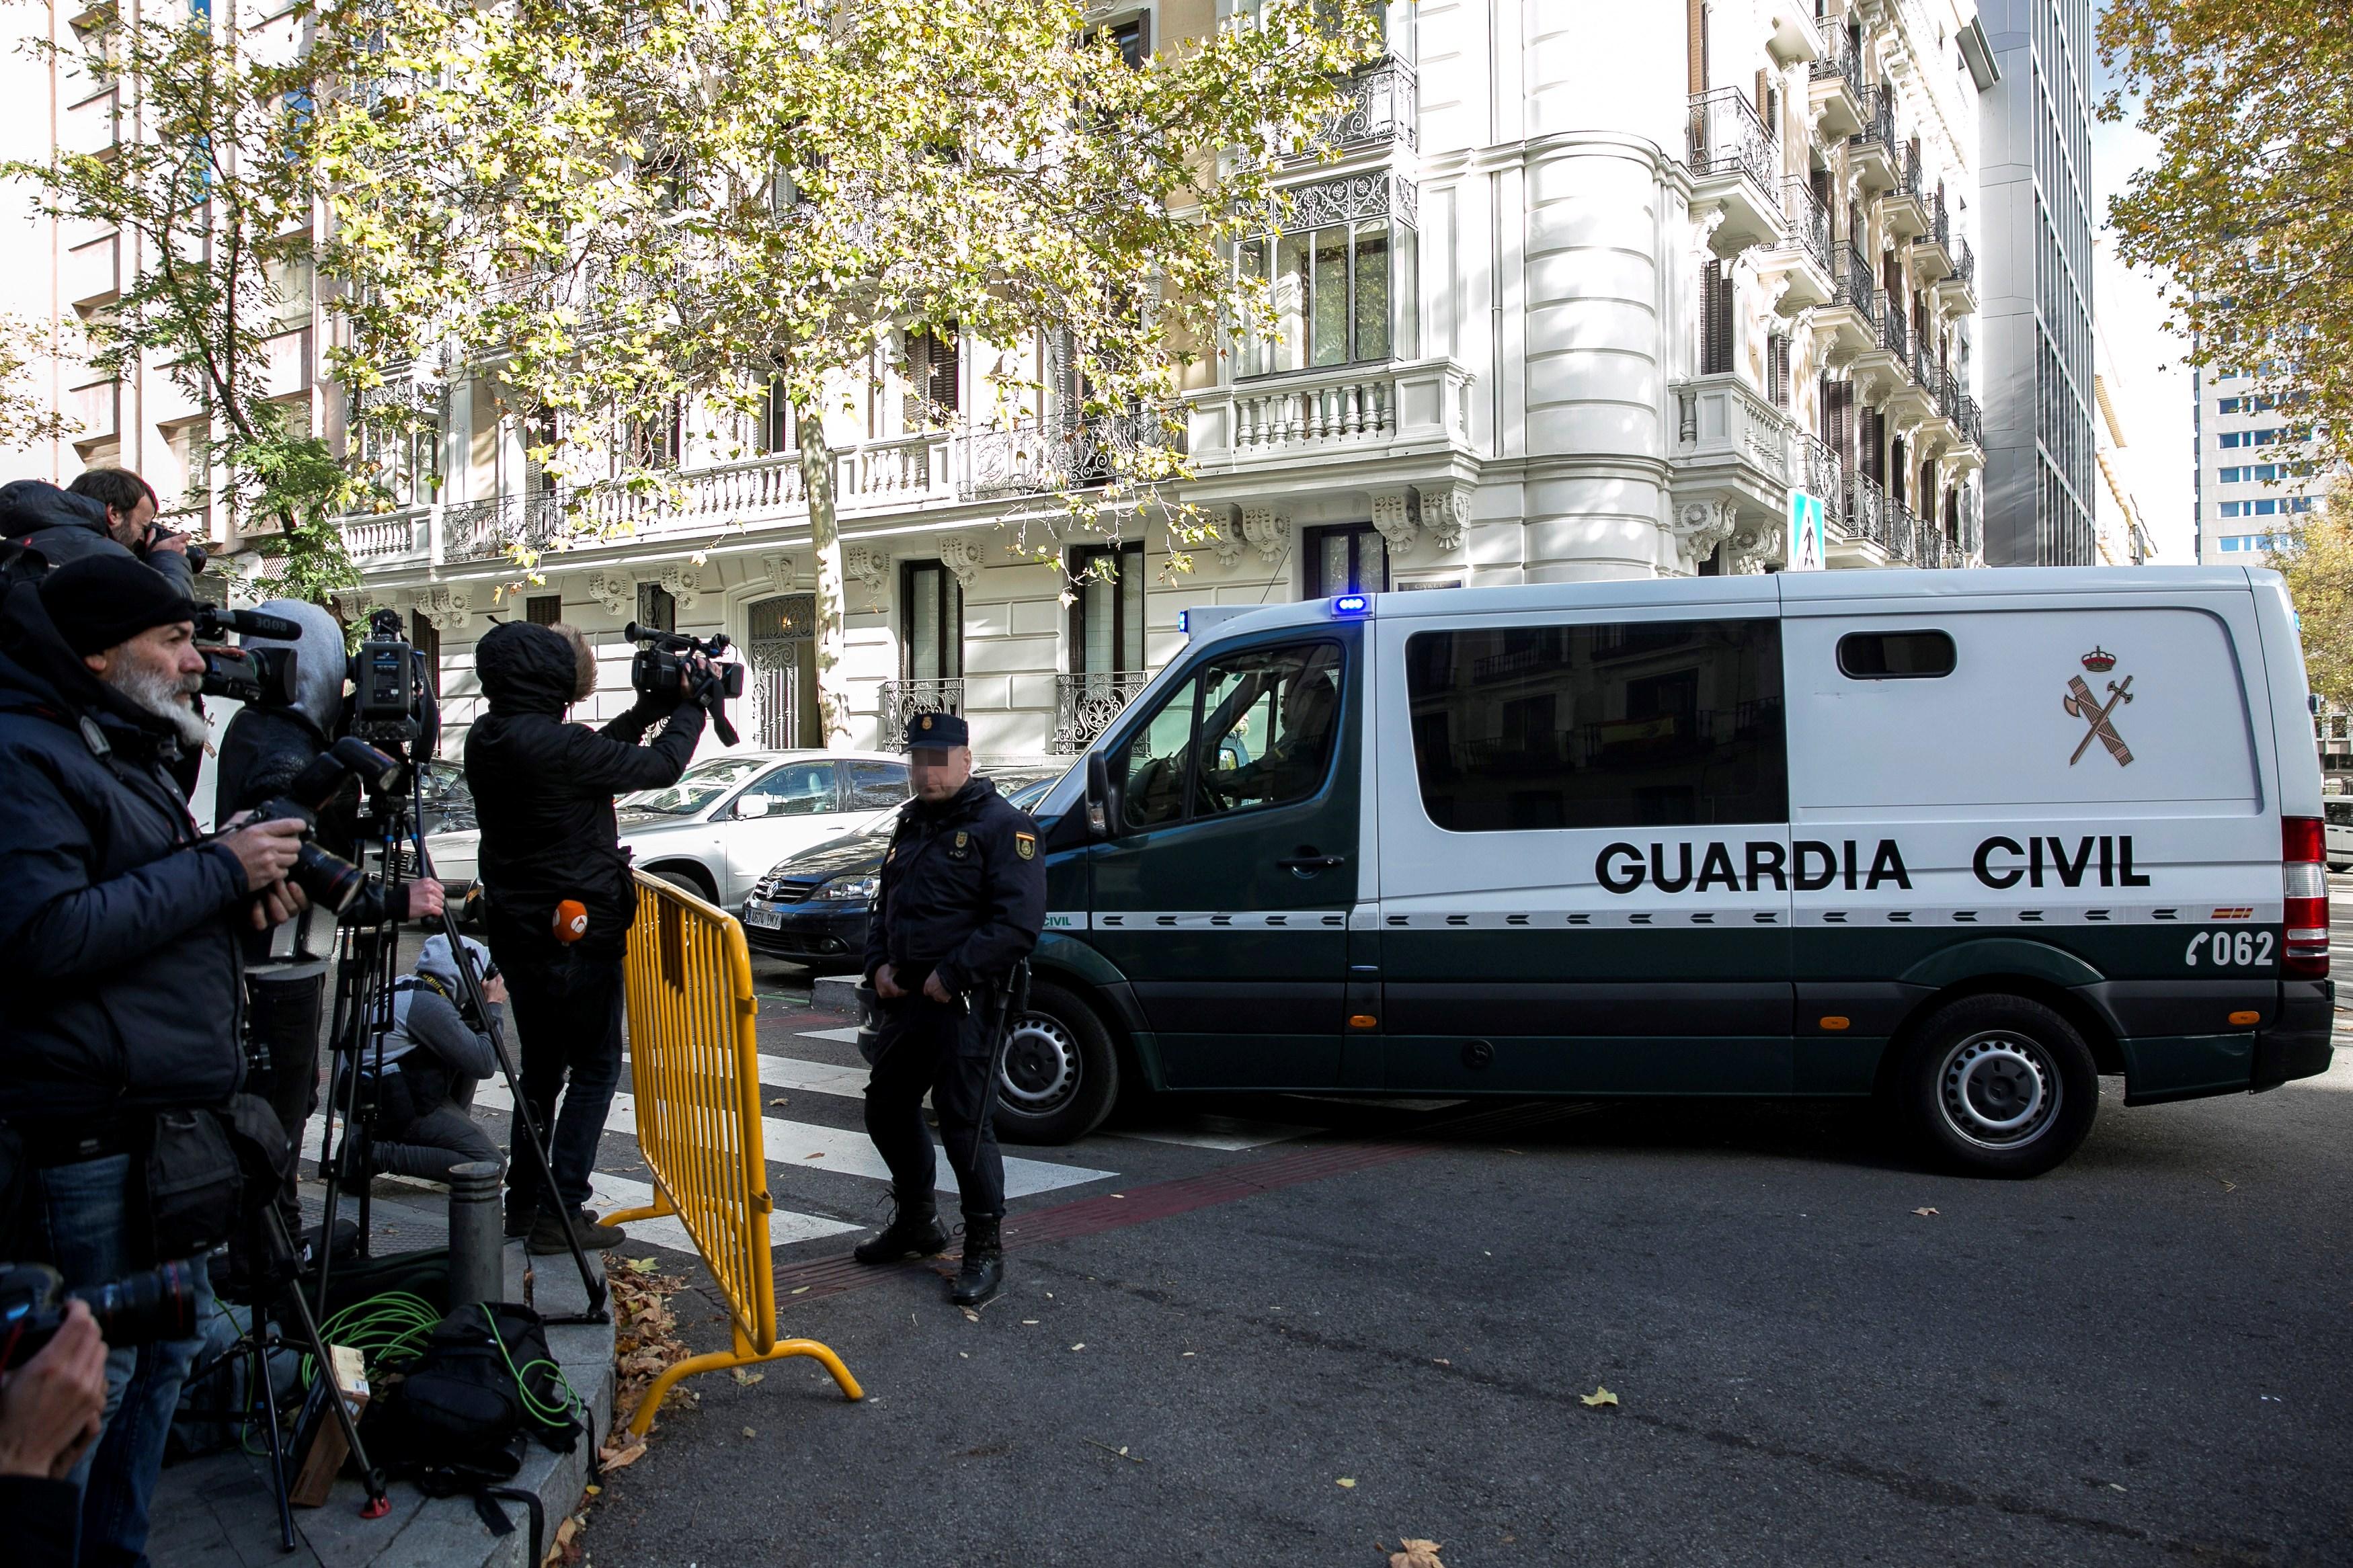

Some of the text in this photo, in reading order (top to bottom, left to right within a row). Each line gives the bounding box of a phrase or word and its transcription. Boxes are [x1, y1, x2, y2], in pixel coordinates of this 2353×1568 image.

[1595, 835, 2151, 894] GUARDIA CIVIL
[751, 911, 780, 927] 4674 DKX
[1043, 916, 1072, 926] CIVIL
[2212, 931, 2274, 966] 062
